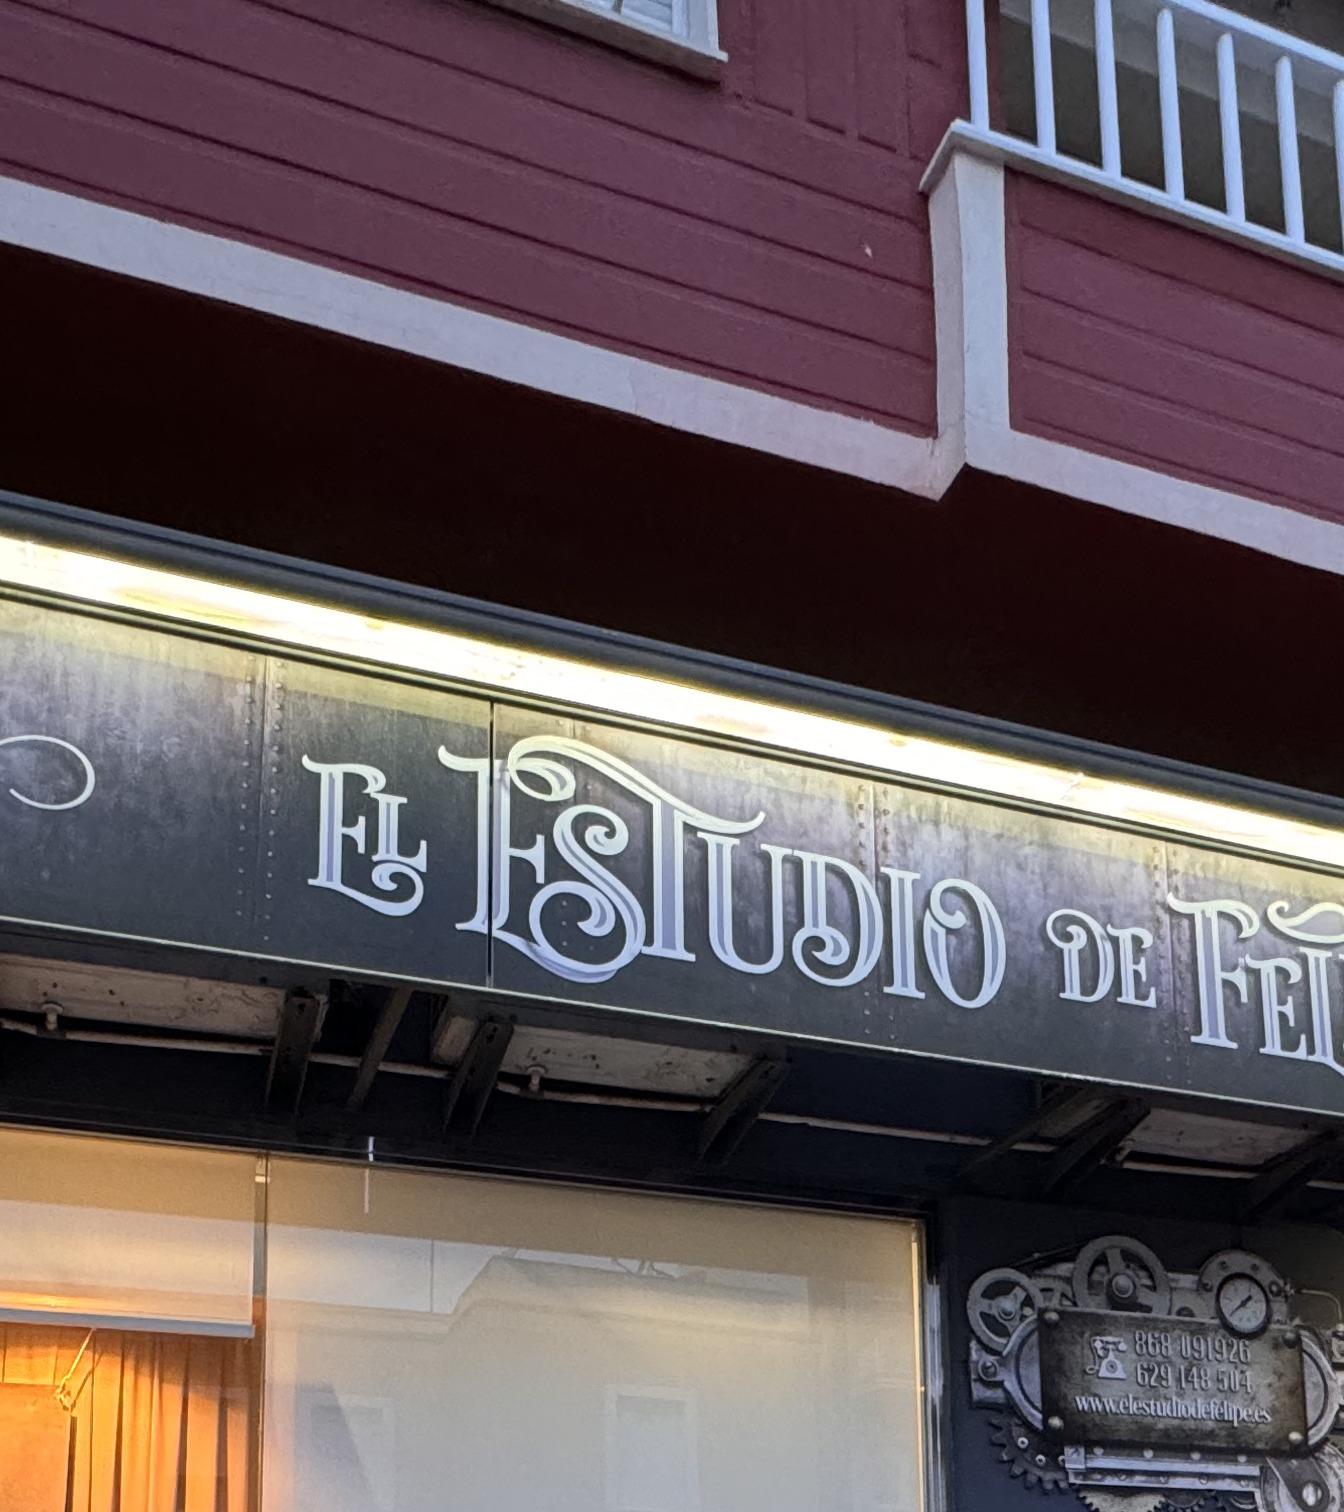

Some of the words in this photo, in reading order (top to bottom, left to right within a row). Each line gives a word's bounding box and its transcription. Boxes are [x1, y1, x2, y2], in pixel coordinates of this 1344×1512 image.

[302, 754, 427, 917] EL
[438, 734, 1006, 1009] ESTUDIO
[1046, 908, 1157, 1009] DE
[1135, 1330, 1172, 1358] 868
[1180, 1334, 1252, 1364] 091926
[1136, 1361, 1173, 1388] 629
[1179, 1365, 1212, 1391] 148
[1216, 1369, 1253, 1394] 504
[1074, 1394, 1272, 1427] www.elestudiodefelipe.es
